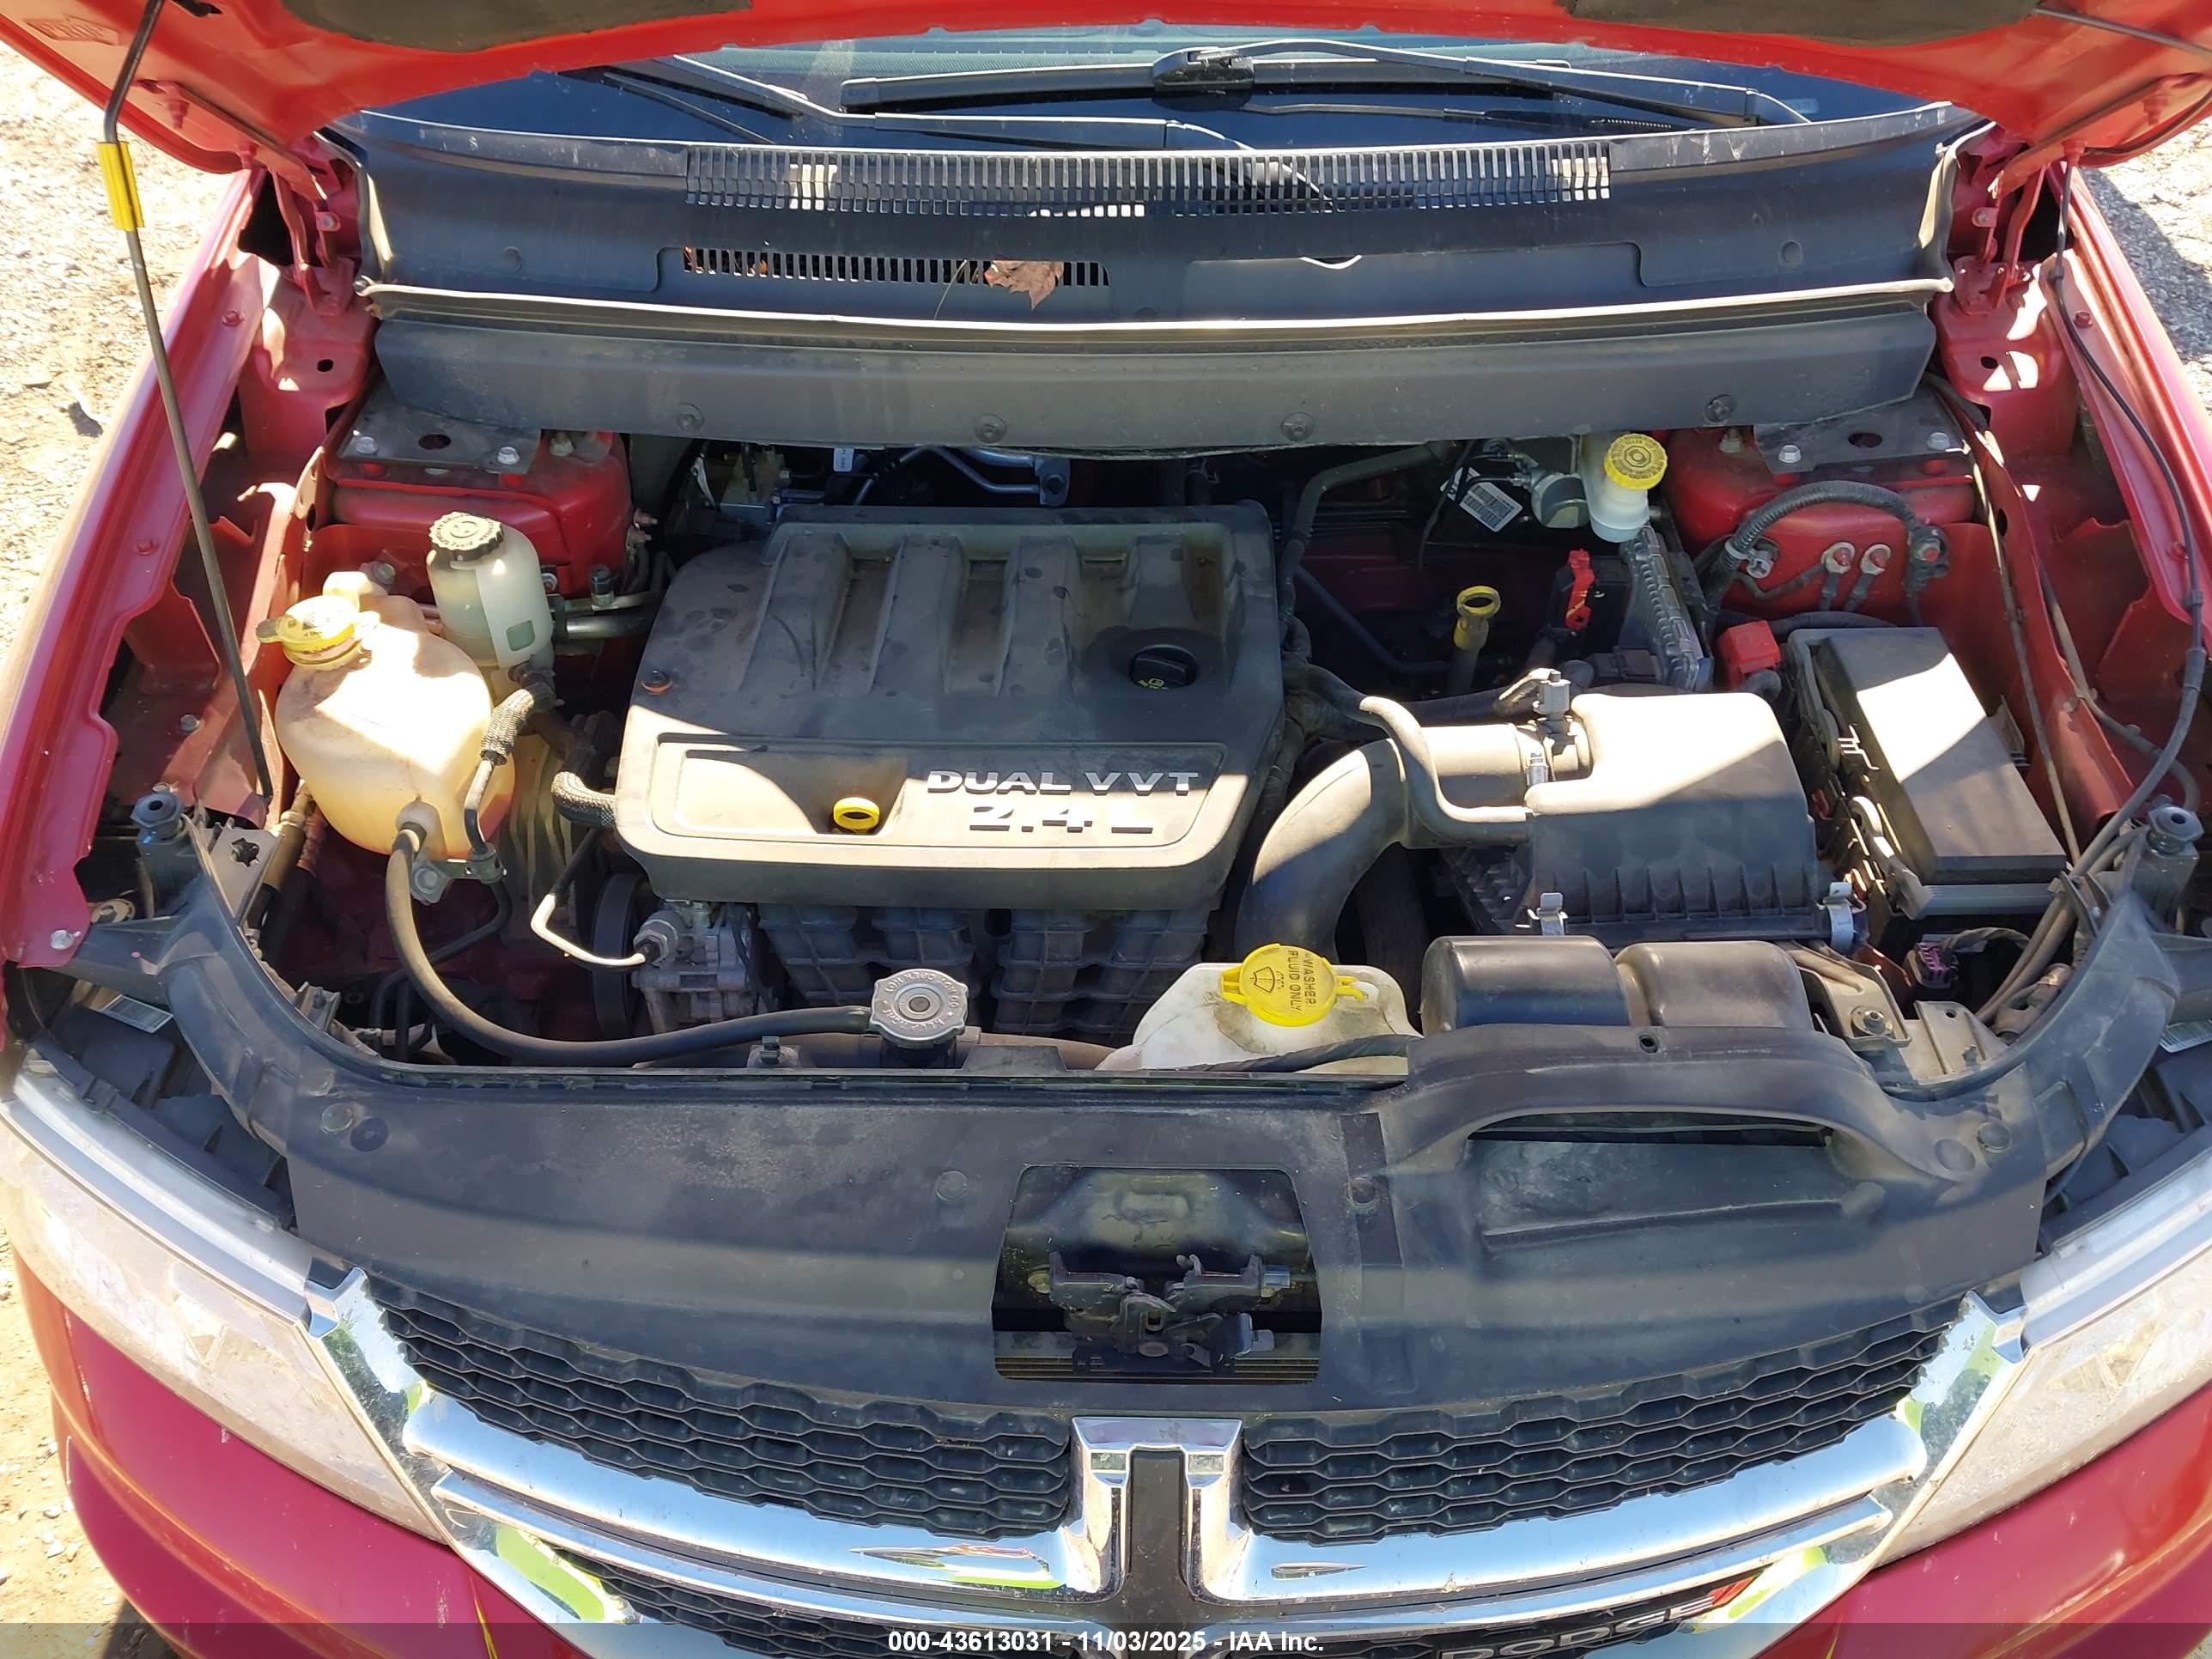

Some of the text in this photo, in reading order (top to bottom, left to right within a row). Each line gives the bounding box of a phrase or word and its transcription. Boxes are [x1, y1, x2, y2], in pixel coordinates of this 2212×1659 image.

[927, 770, 1199, 796] DUAL VVT
[1287, 950, 1303, 1012] FLUID ONLY
[1302, 957, 1317, 1005] WASHER
[1441, 1595, 1716, 1659] DODGE
